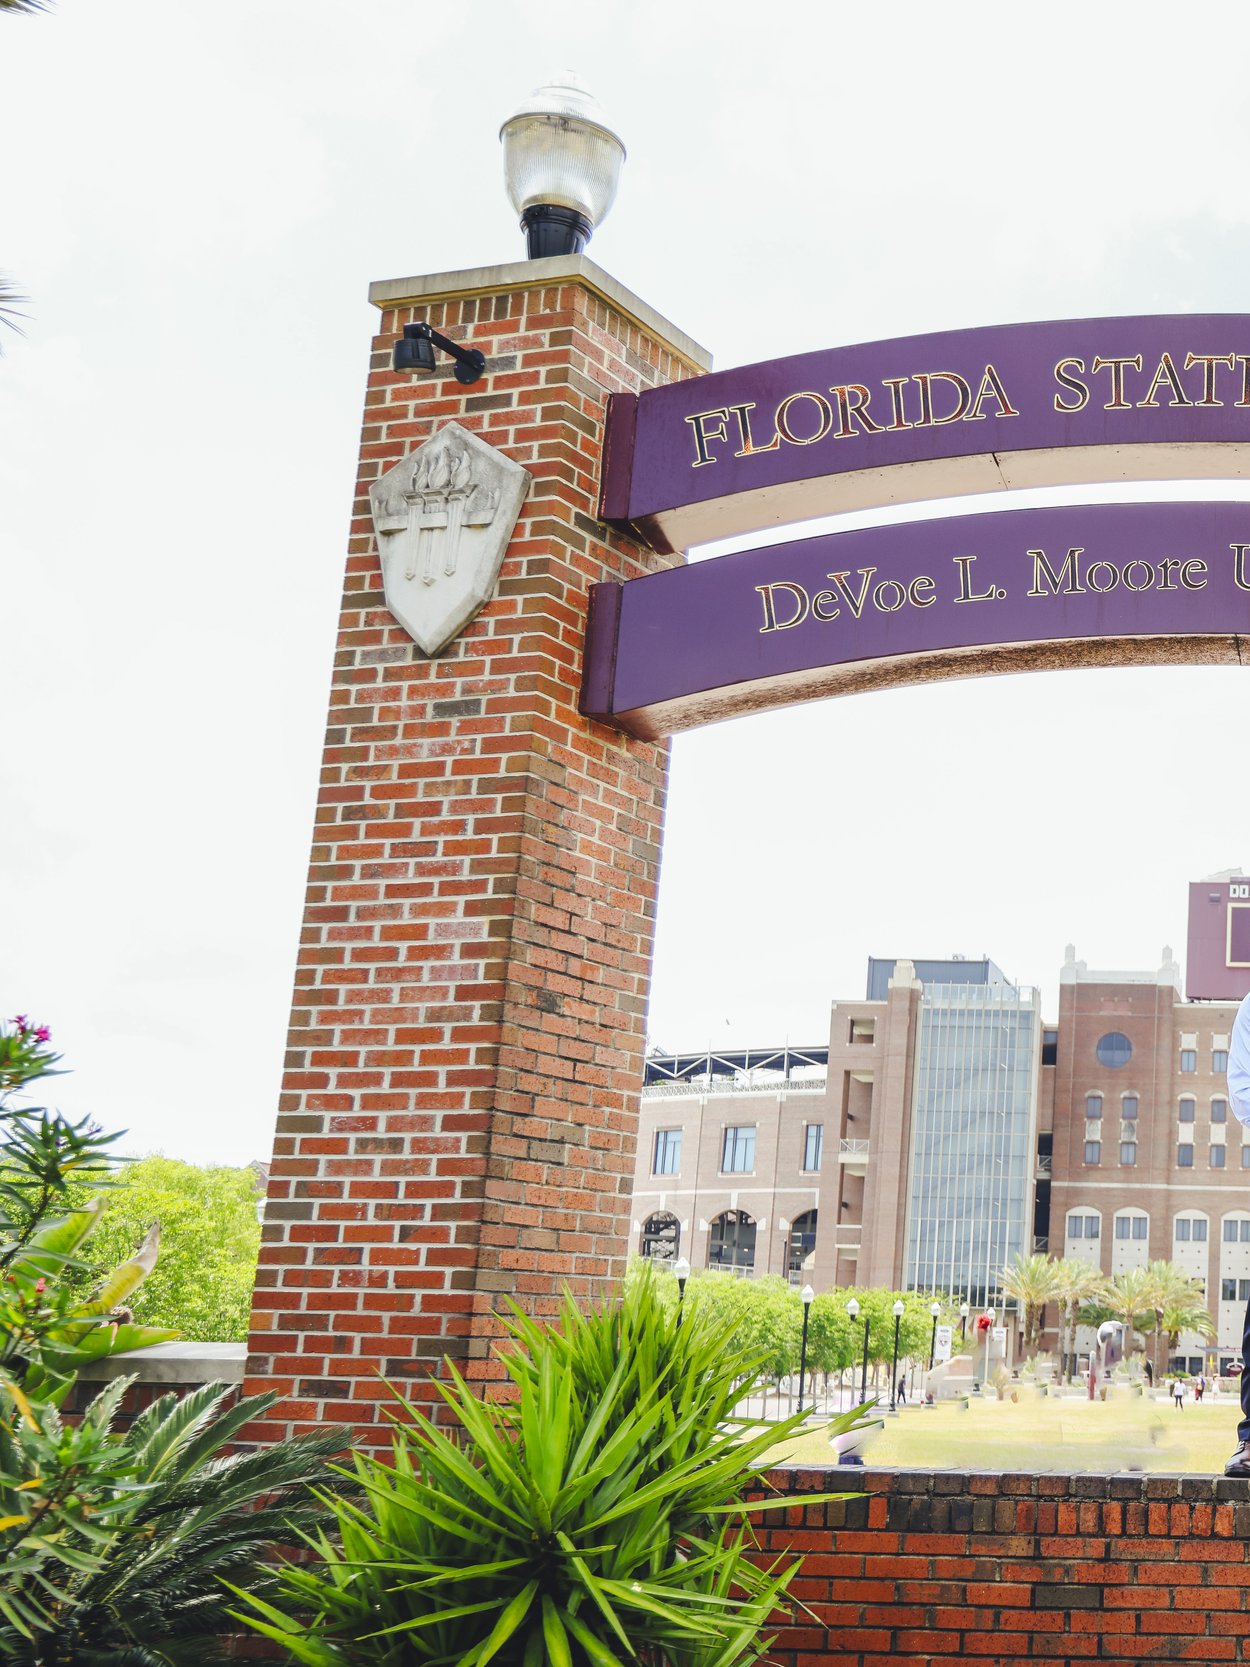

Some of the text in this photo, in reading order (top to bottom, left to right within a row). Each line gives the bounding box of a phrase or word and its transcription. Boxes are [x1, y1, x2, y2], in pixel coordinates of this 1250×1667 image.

[685, 364, 1019, 467] FLORIDA
[755, 566, 937, 634] DeVoe
[953, 555, 1007, 603] L.
[1026, 547, 1208, 597] Moore
